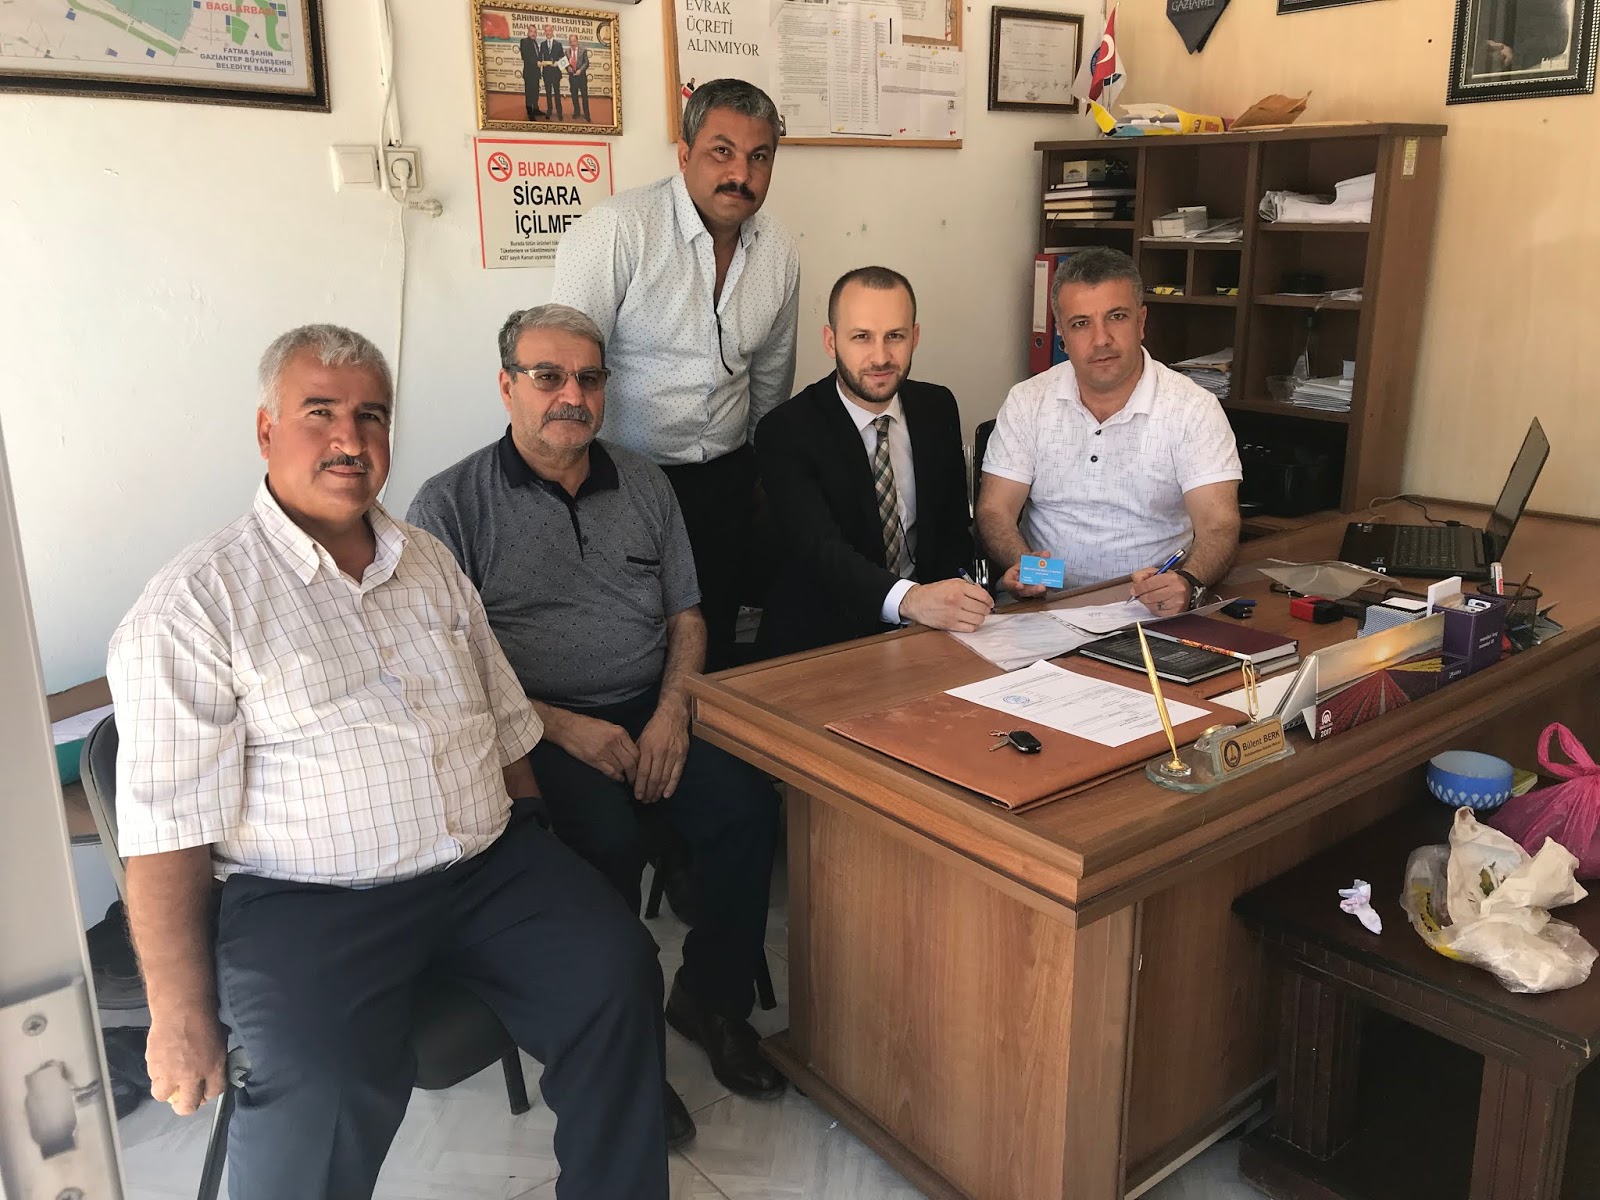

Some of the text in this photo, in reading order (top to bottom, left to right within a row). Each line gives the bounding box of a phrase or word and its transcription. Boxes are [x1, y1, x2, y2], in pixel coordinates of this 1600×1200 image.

[686, 0, 731, 14] EVRAK
[686, 15, 732, 35] ÜÇRETİ
[223, 47, 249, 55] FATMA
[687, 38, 759, 56] ALINMIYOR
[518, 161, 574, 177] BURADA
[513, 180, 582, 206] SİGARA
[515, 210, 582, 239] İÇİLME
[1242, 738, 1262, 751] Bülent
[1263, 731, 1280, 743] BERK
